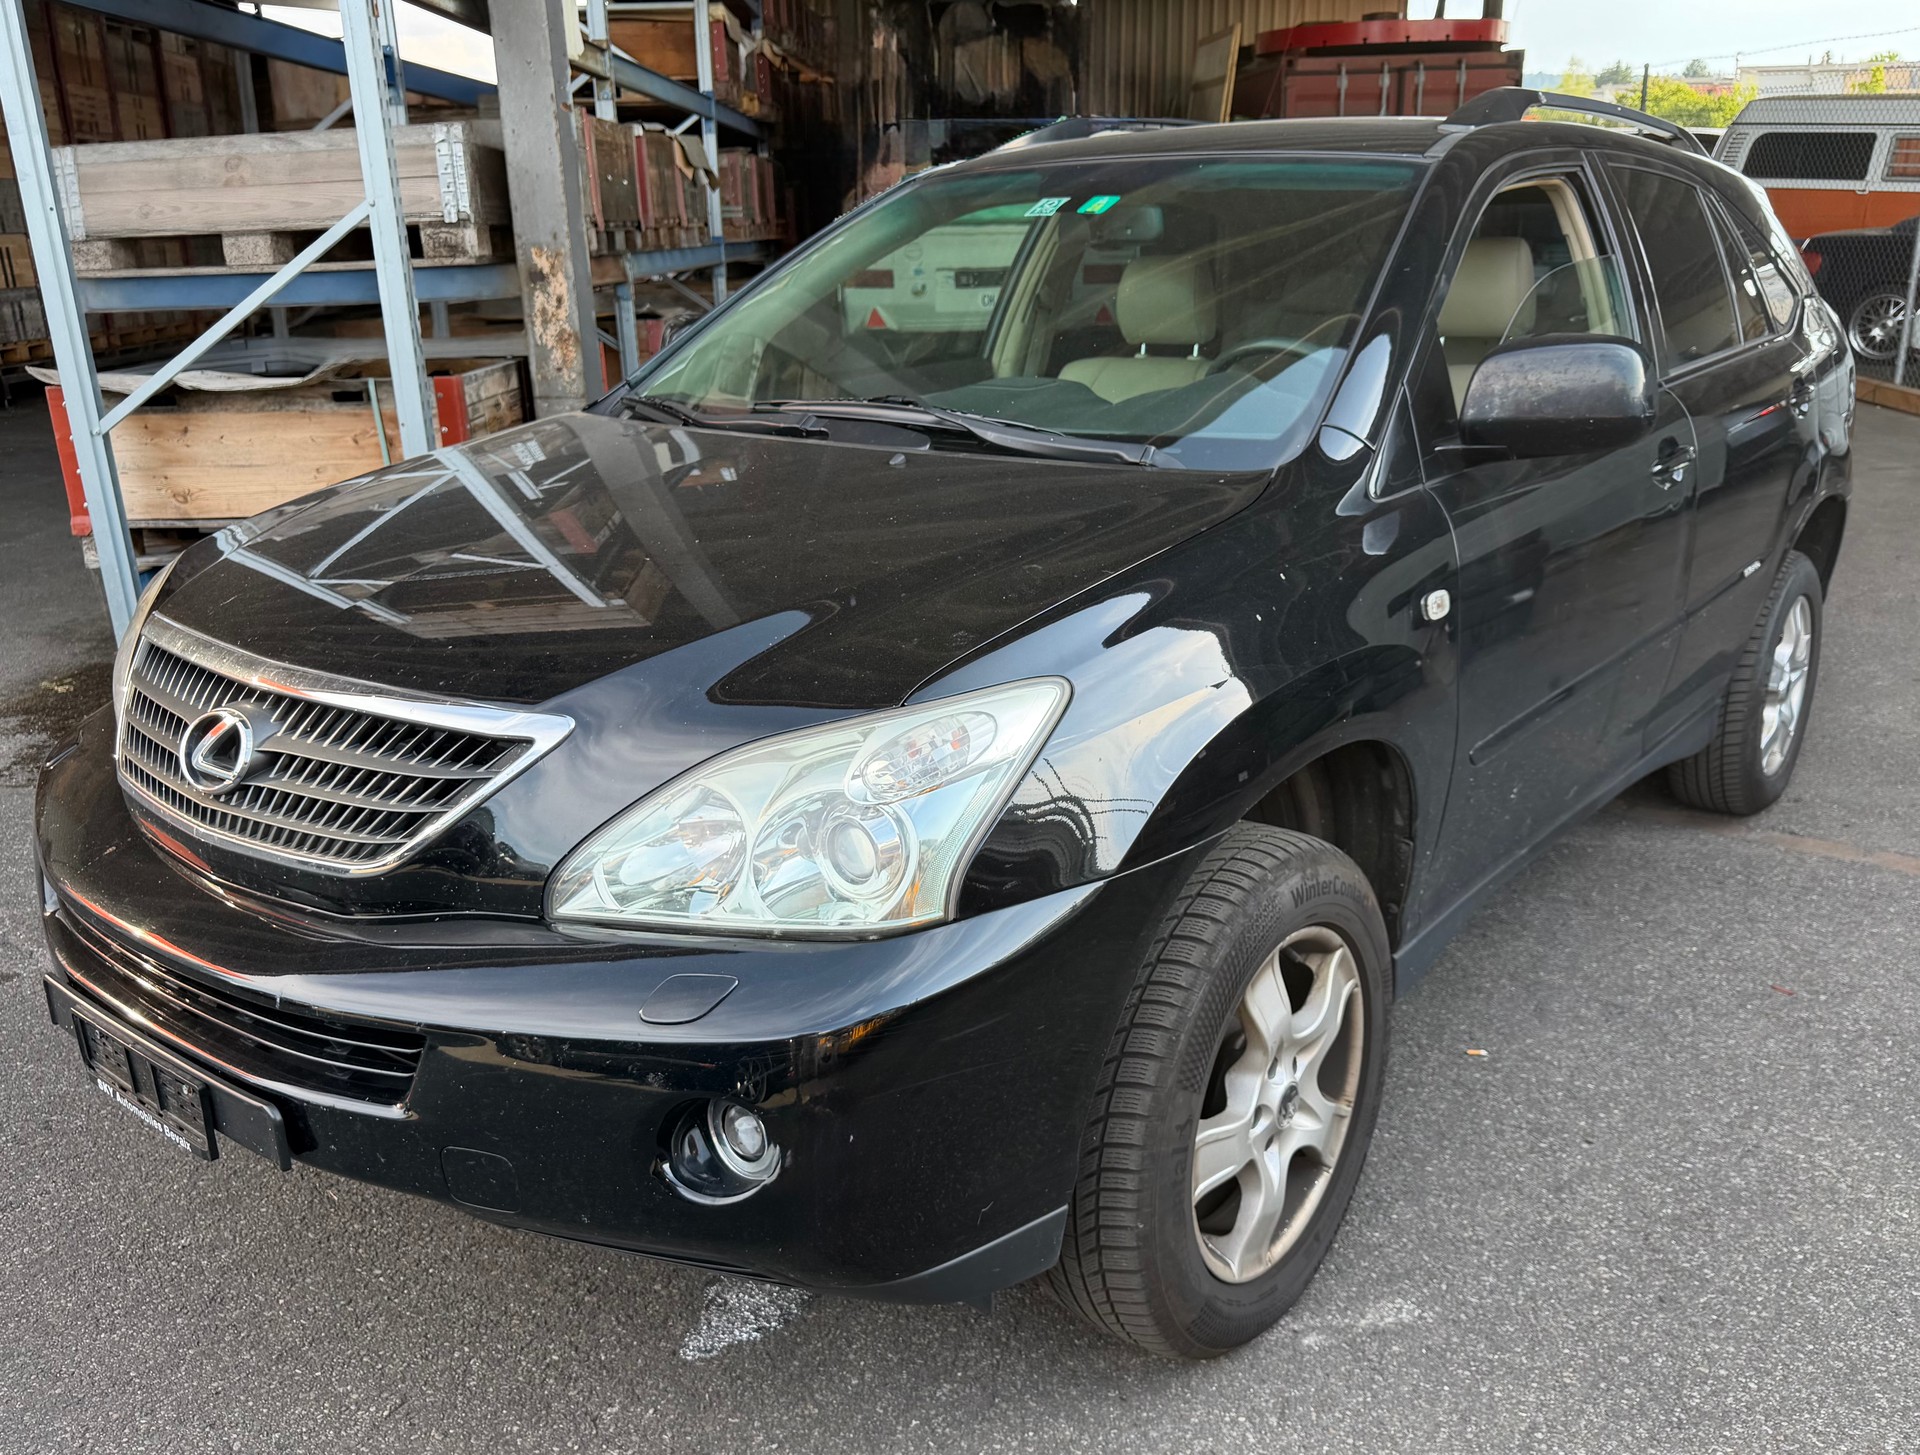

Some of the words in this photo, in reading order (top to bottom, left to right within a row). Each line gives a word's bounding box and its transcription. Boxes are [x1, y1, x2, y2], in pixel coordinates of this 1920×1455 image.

[1290, 875, 1369, 909] WinterConta
[97, 1078, 114, 1098] SKY
[116, 1091, 163, 1132] Automobiles
[163, 1124, 192, 1152] Bevaix
